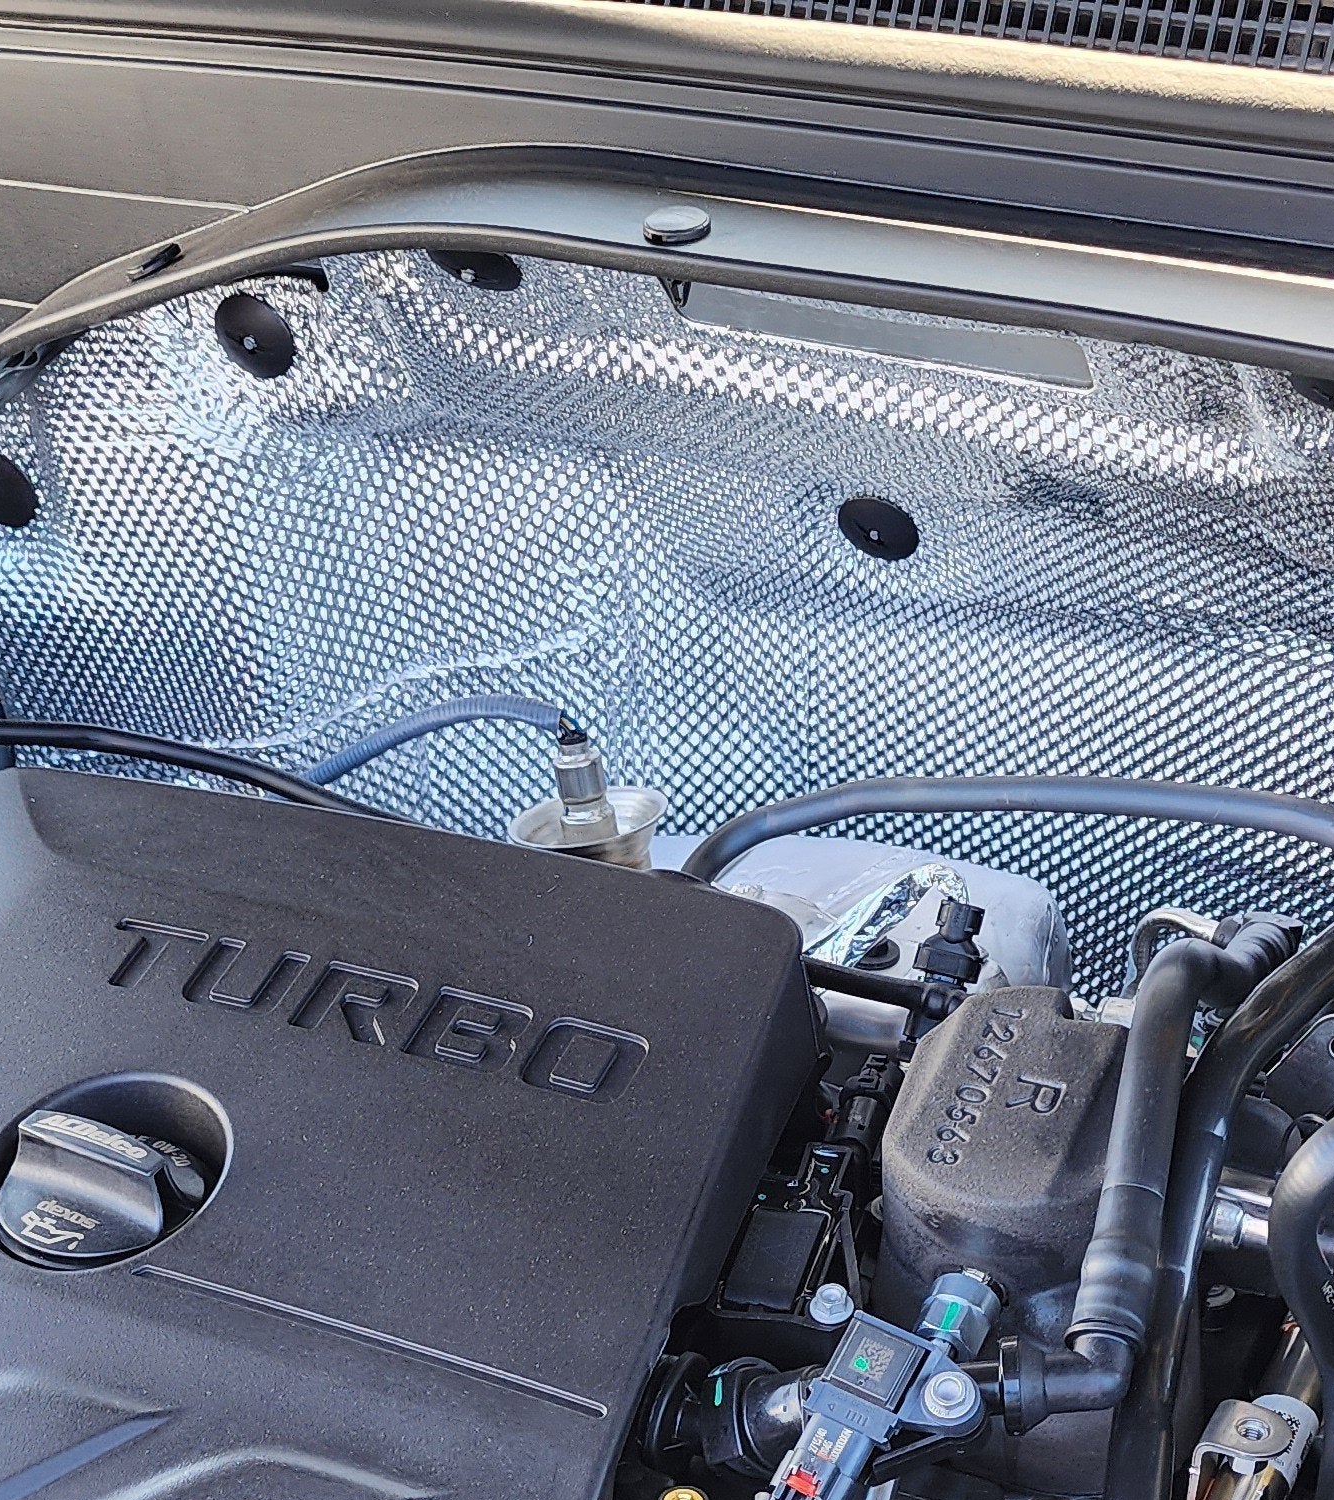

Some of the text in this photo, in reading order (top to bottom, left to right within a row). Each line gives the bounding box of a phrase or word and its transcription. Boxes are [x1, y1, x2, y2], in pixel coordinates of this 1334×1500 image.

[109, 917, 649, 1103] TURBO
[1006, 1074, 1068, 1116] R
[32, 1114, 147, 1160] ACDelco
